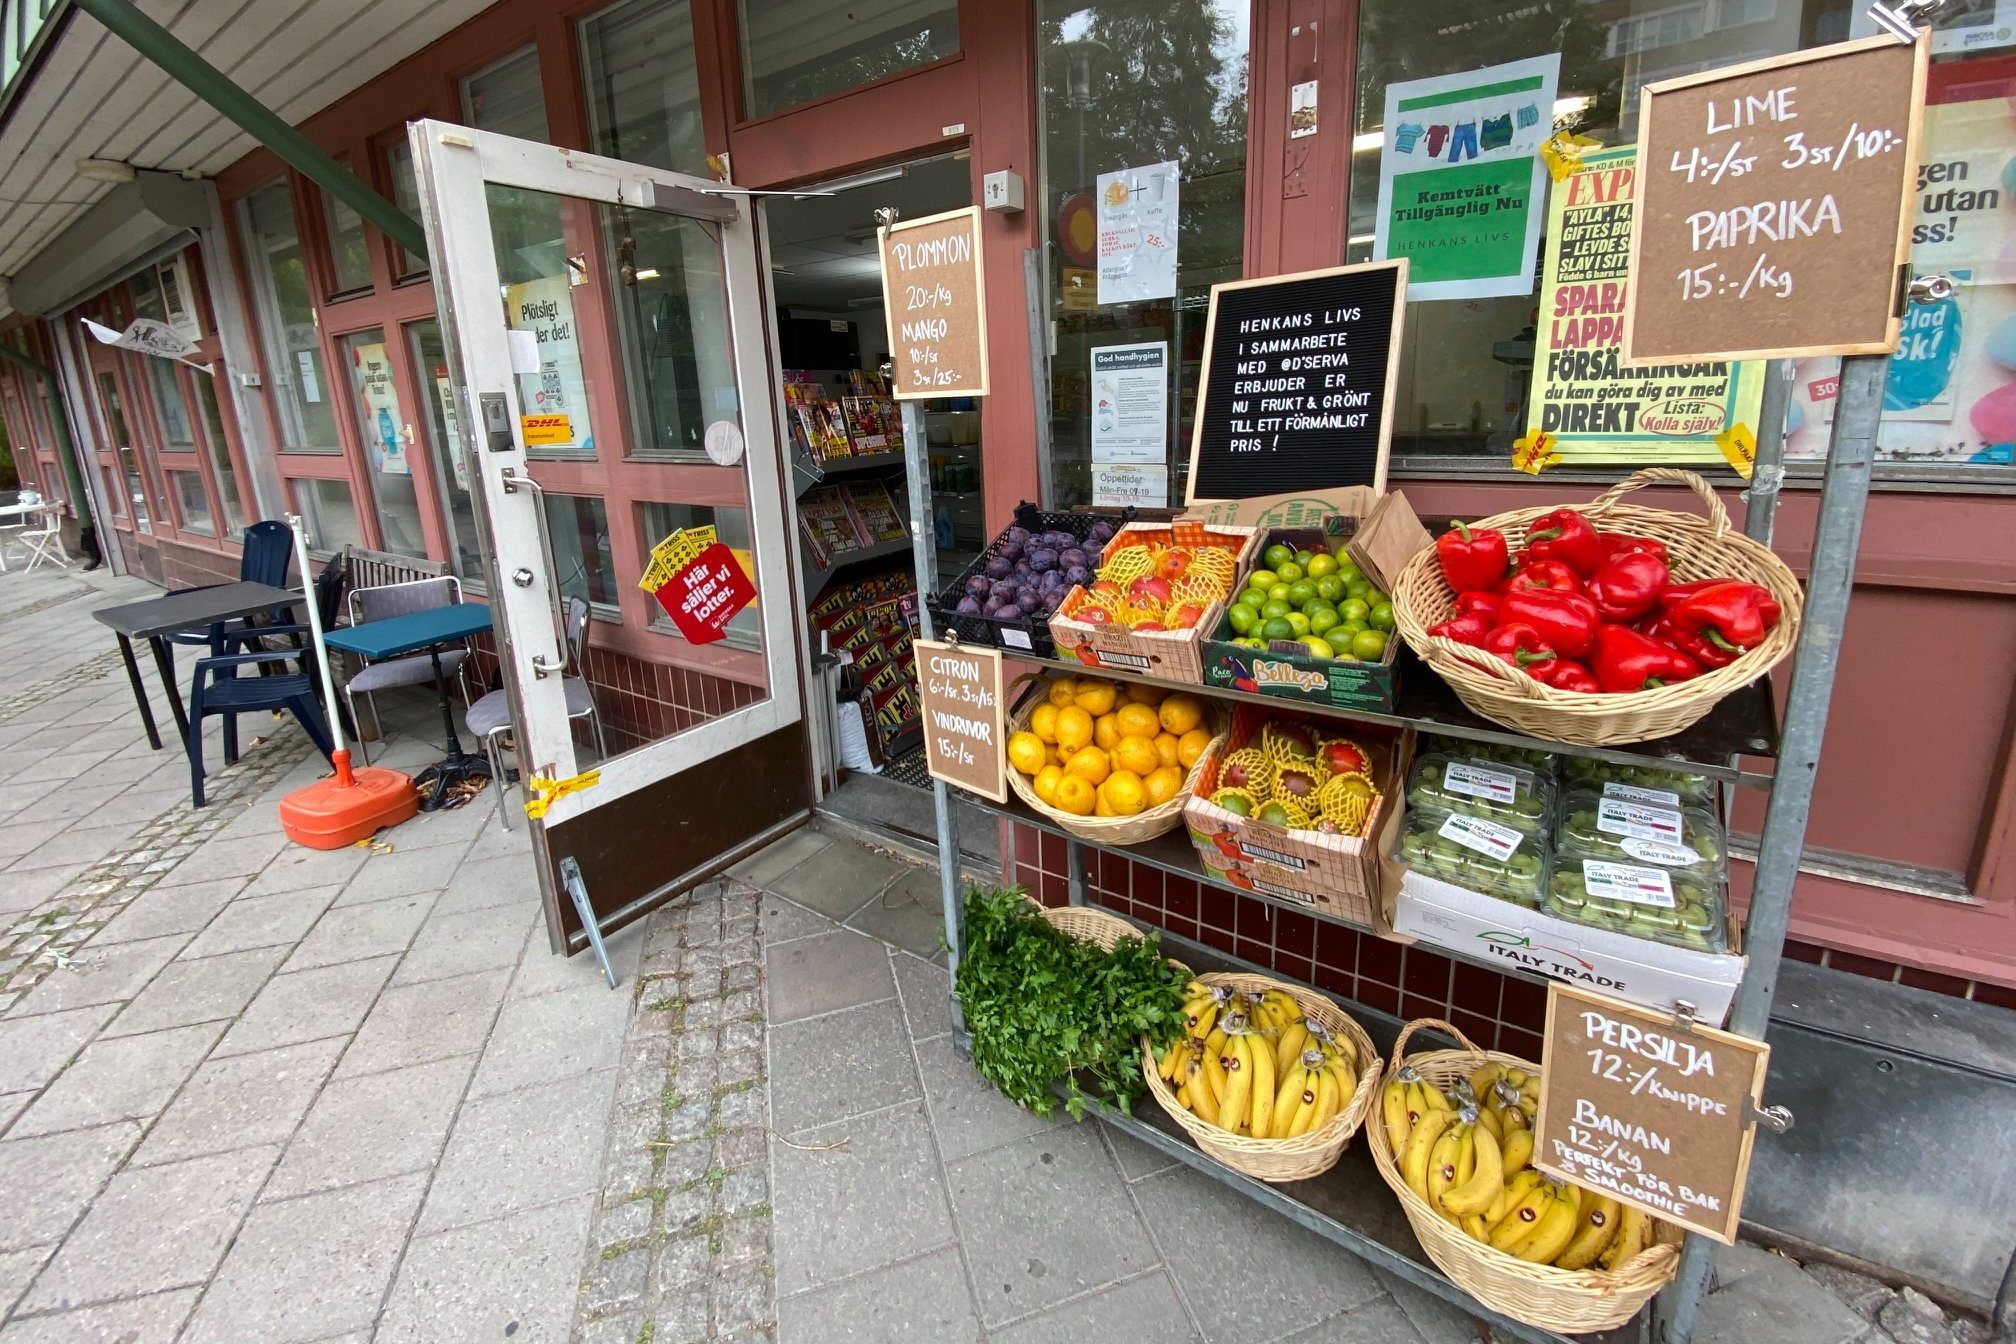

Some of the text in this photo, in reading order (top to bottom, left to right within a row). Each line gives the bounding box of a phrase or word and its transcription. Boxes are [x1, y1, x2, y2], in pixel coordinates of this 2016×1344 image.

[1707, 87, 1798, 134] LIME
[1418, 183, 1501, 205] Kemtvätt
[1566, 168, 1635, 207] EXP
[1396, 197, 1524, 222] Tillgänglig Nu
[1923, 188, 1999, 213] utan
[1563, 223, 1610, 241] GIFTES
[1686, 194, 1842, 251] PAPRIKA
[892, 233, 970, 272] PLOMMON
[1398, 232, 1510, 251] HENKANS LIVS
[1574, 238, 1617, 256] LEVDE
[1560, 256, 1594, 272] SLAV
[1594, 270, 1614, 278] barn
[522, 300, 559, 322] Plötsligt
[1240, 308, 1361, 333] HENKANS LIVS
[552, 322, 571, 342] det!
[902, 318, 947, 343] MANGO
[1239, 332, 1348, 355] I SAMMARBETE
[1098, 352, 1160, 363] God handhygien
[1237, 360, 1267, 375] MED
[1234, 374, 1346, 395] ERBJUDER ER
[1545, 379, 1728, 403] du kan göra dig av med
[1232, 390, 1371, 414] NU FRUKT & GRÖNT
[1664, 401, 1706, 415] Lista:
[526, 418, 562, 428] DHL
[1230, 420, 1254, 433] TILL
[1258, 418, 1282, 432] ETT
[1542, 402, 1640, 433] DIREKT
[1644, 416, 1723, 433] Kolla själv!
[1230, 434, 1279, 452] PRIS !
[1100, 473, 1143, 484] Öppettider
[664, 535, 681, 550] TRISS
[693, 530, 710, 538] TRISS
[683, 564, 710, 590] Här
[682, 564, 732, 614] säljer vi
[693, 586, 735, 623] lotter.
[930, 656, 980, 683] CITRON
[1253, 658, 1327, 691] Belleza
[932, 710, 992, 746] VINDRUVOR
[1454, 771, 1492, 784] ITALY TRADE
[1608, 809, 1654, 821] ITALY TRADE
[1456, 817, 1496, 837] ITALY TRADE
[1639, 850, 1687, 863] ITALY TRADE
[1592, 872, 1640, 883] ITALY TRADE
[1489, 944, 1626, 991] ITALY TRADE
[1580, 1012, 1715, 1077] PERSILJA
[1572, 1098, 1671, 1155] BANAN
[1552, 1139, 1627, 1178] PERFEKT
[1678, 1186, 1720, 1212] BAK
[1584, 1168, 1688, 1217] SMOOTHIE
